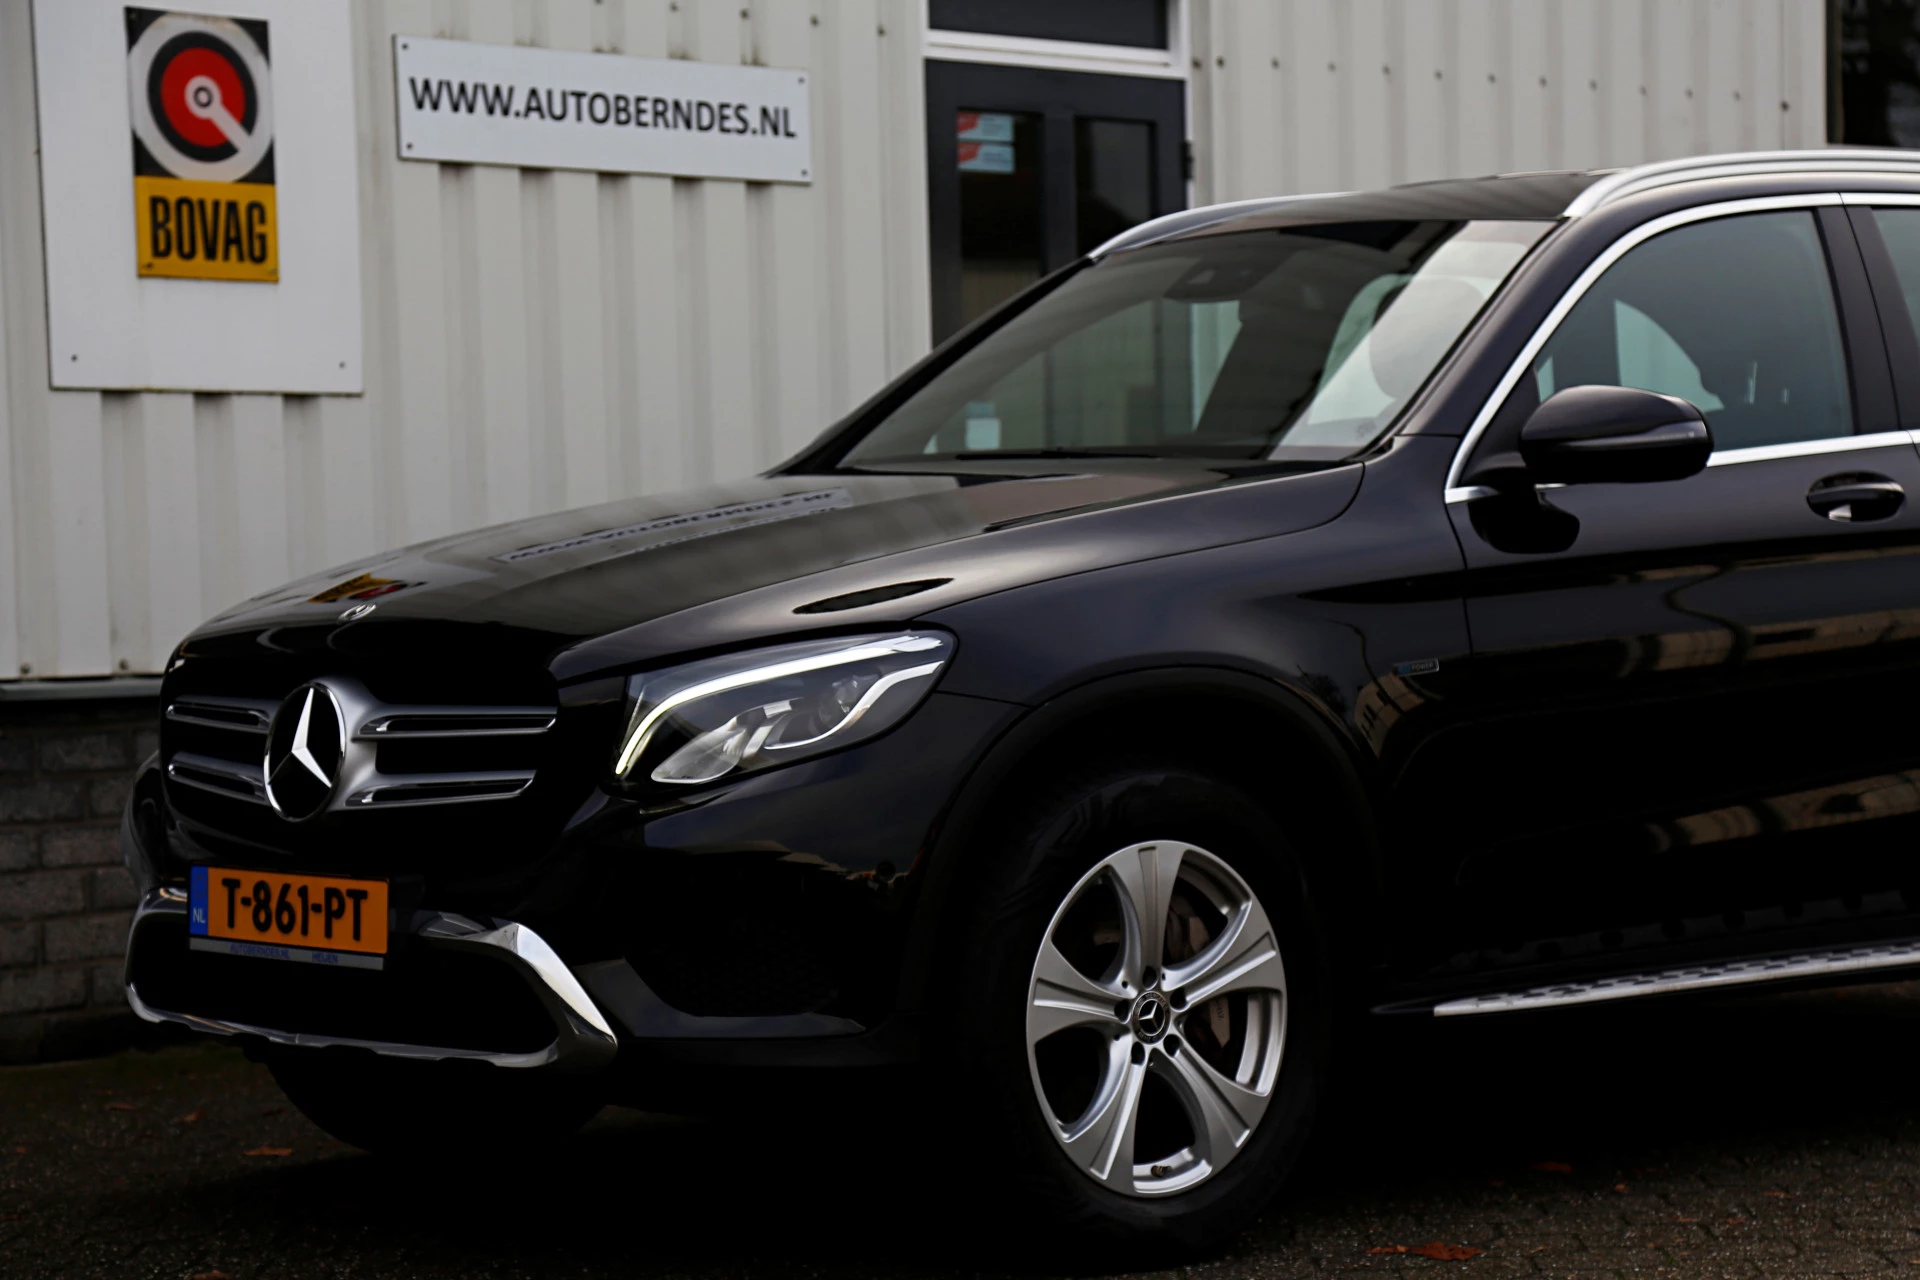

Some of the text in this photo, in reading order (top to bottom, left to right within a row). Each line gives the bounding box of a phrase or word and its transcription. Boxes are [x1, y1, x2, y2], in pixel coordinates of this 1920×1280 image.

[409, 77, 797, 138] WWW.AUTOBERNDES.NL
[149, 195, 267, 265] BOVAG
[193, 908, 206, 924] NL
[221, 878, 368, 942] T-861-PT
